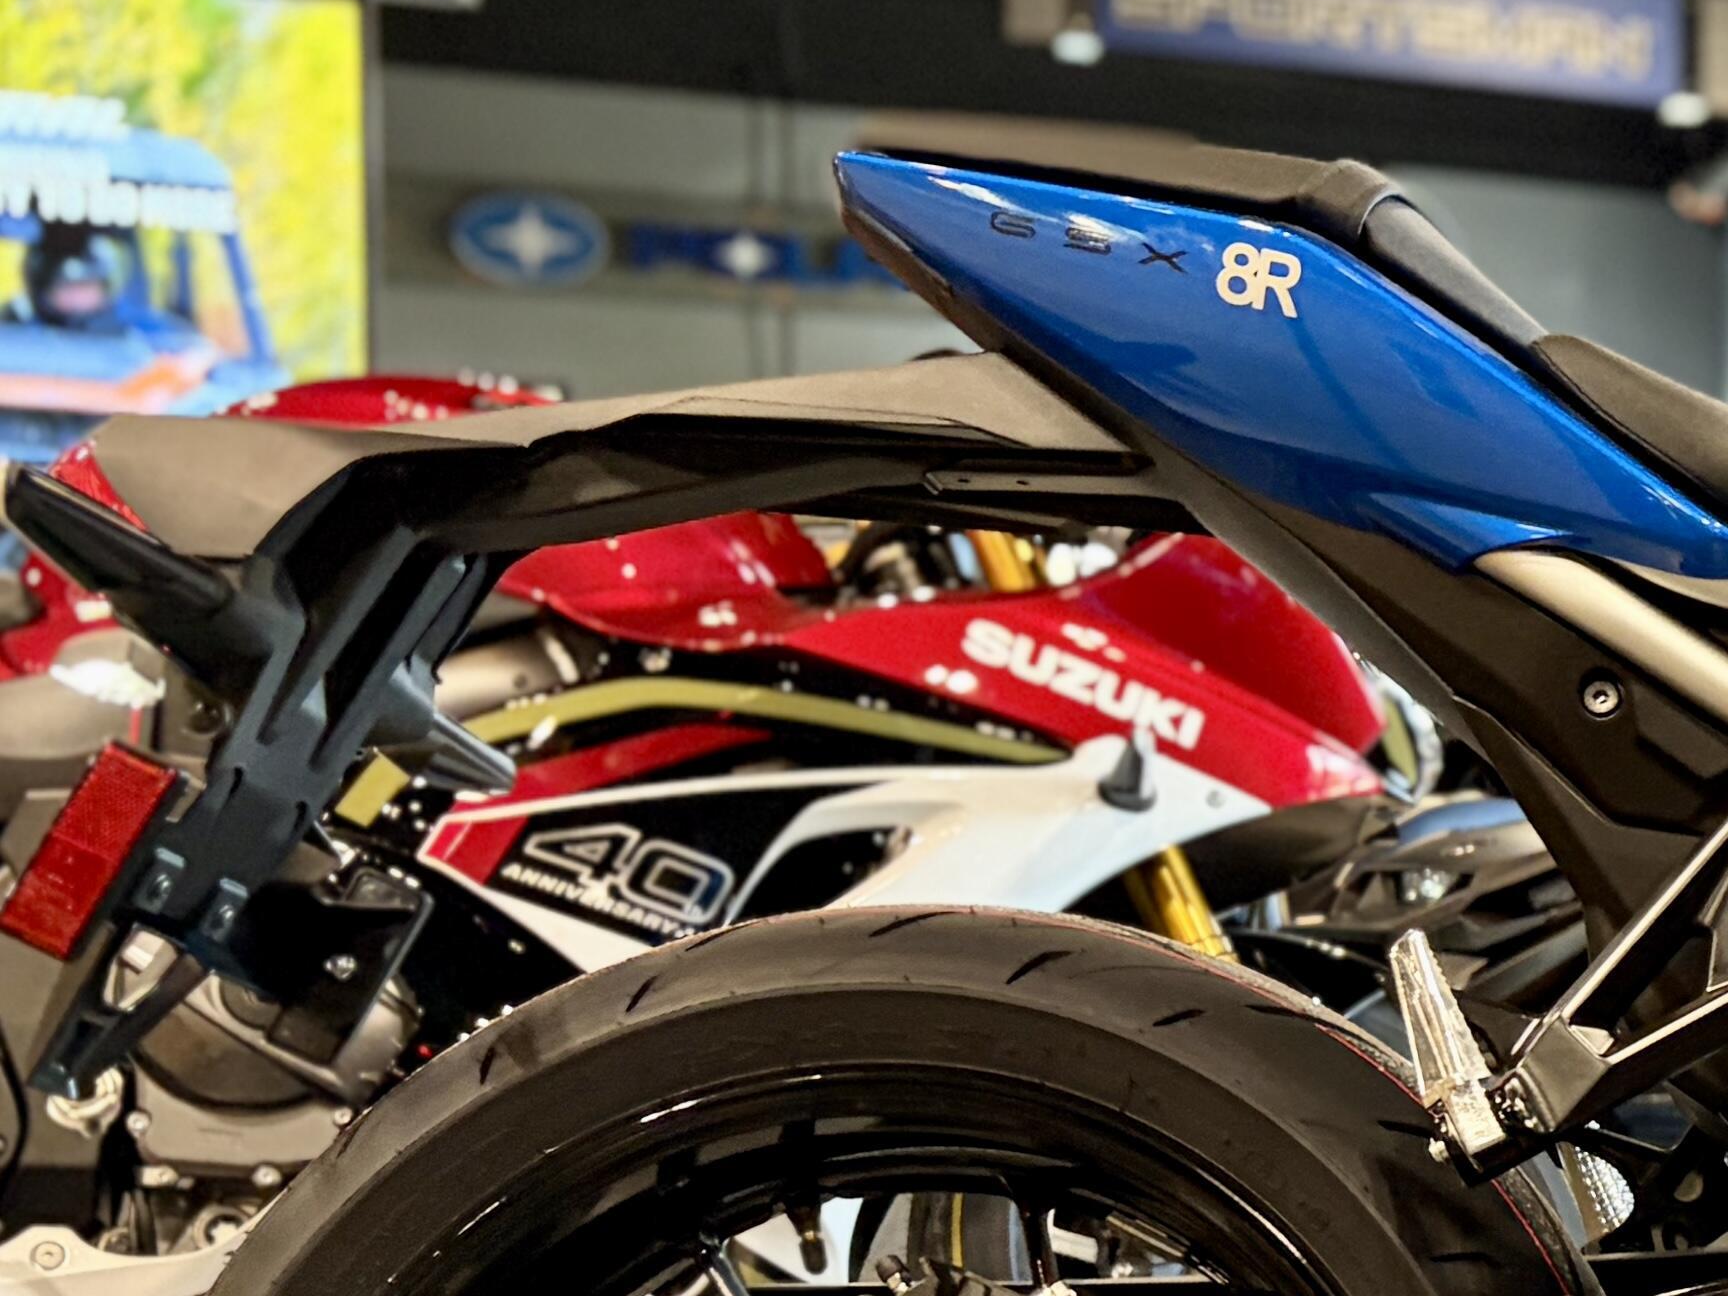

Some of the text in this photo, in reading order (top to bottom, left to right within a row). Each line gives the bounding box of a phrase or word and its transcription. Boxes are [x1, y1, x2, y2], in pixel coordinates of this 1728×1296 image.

[1215, 241, 1302, 319] 8R
[961, 618, 1206, 751] SUZUKI
[523, 822, 735, 925] 40
